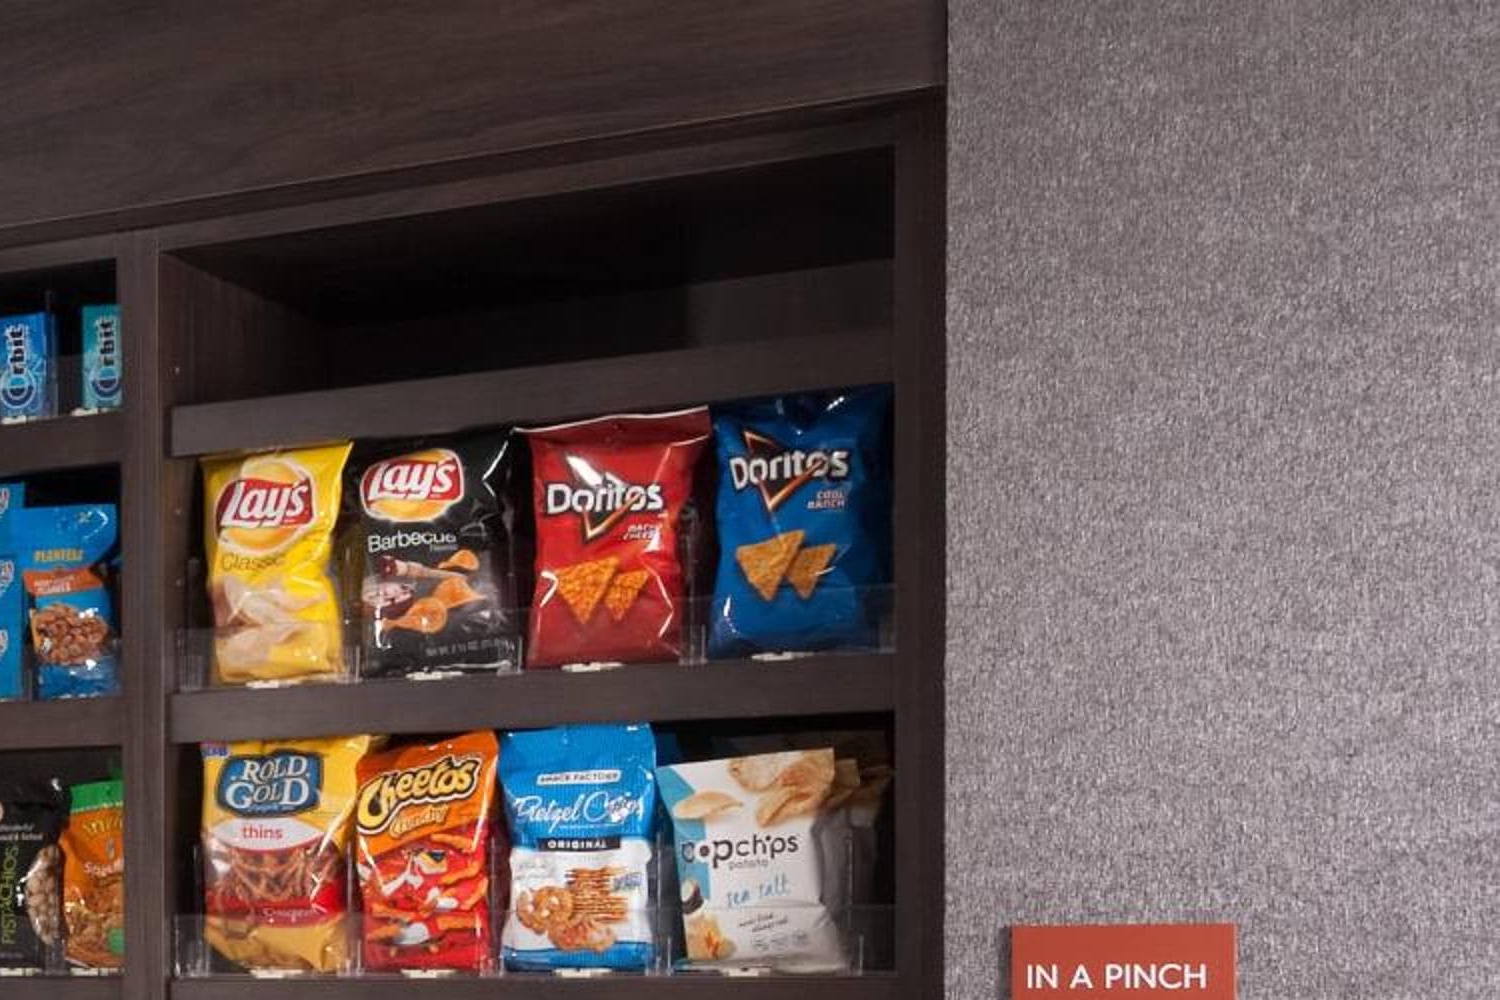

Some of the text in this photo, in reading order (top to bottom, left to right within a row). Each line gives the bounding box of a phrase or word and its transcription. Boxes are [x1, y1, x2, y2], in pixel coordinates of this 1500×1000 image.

[367, 459, 457, 501] Lay's
[729, 450, 849, 491] Doritos
[219, 479, 309, 528] Lay's
[547, 482, 664, 515] Doritos
[367, 531, 457, 553] Barbecue
[357, 757, 481, 830] Cheetos
[243, 824, 283, 840] thins
[547, 839, 608, 849] ORIGINAL
[680, 833, 800, 869] popchips
[758, 873, 791, 900] salt
[1026, 963, 1208, 989] IN A PINCH
